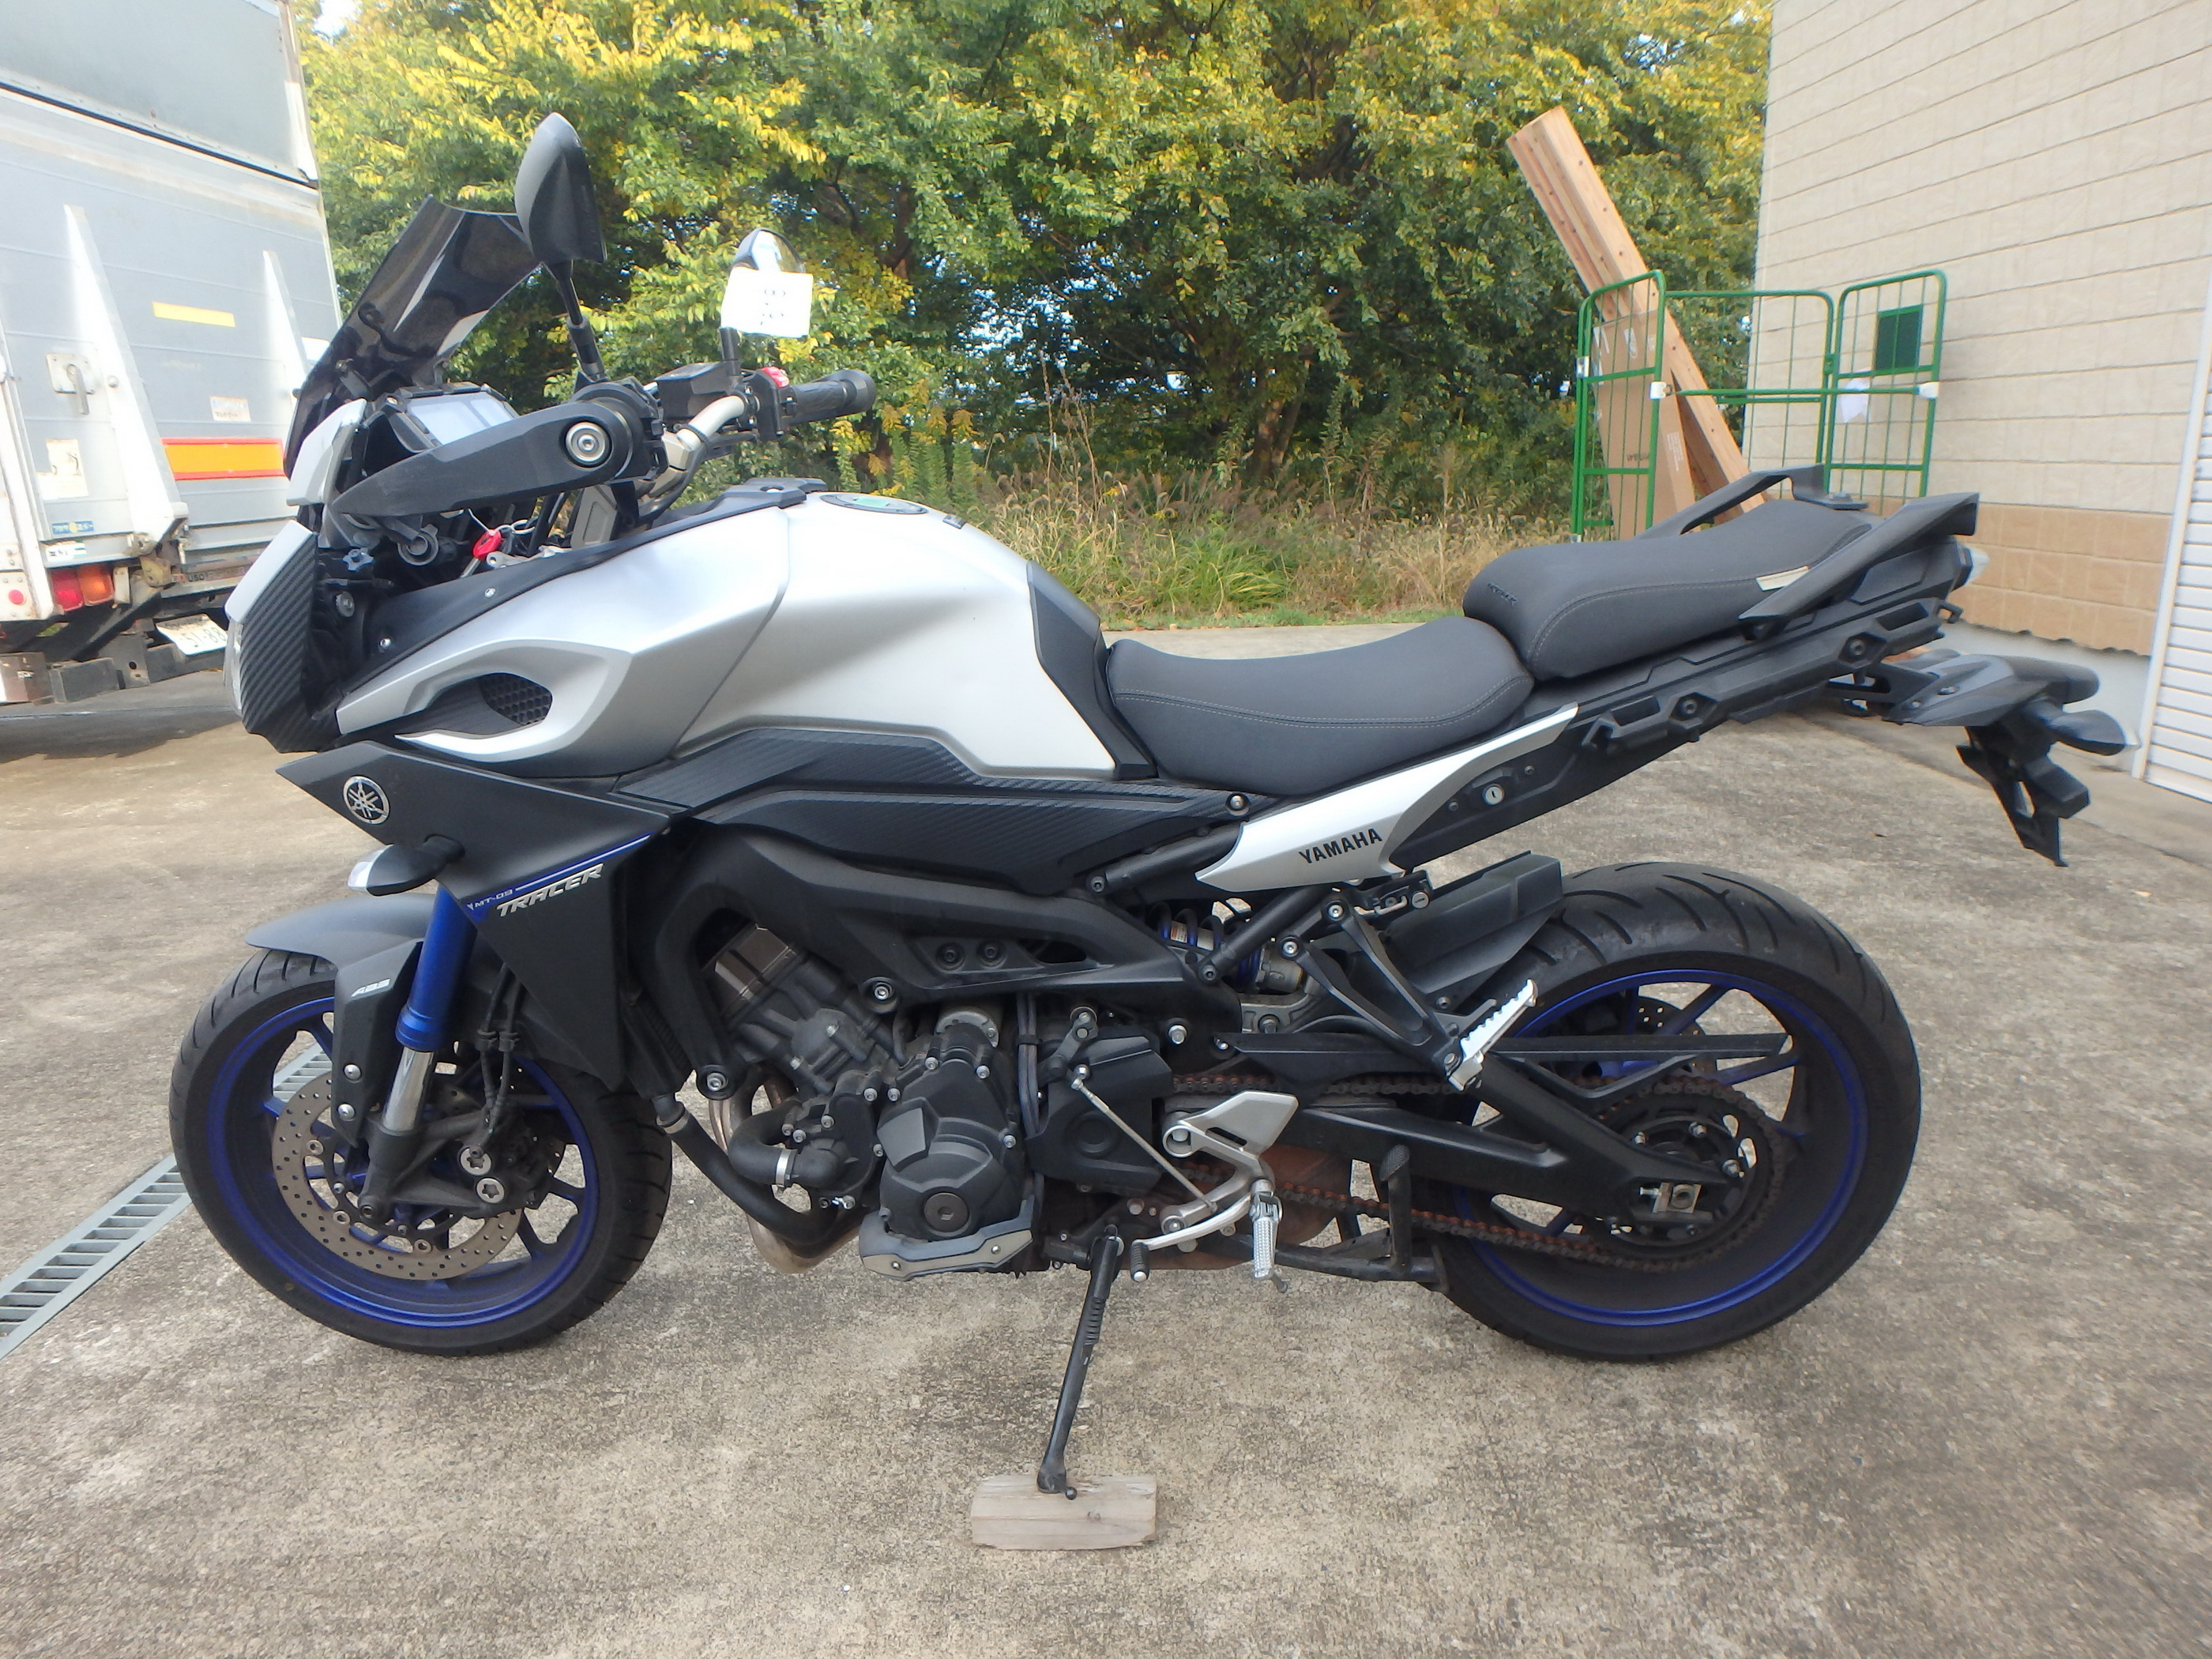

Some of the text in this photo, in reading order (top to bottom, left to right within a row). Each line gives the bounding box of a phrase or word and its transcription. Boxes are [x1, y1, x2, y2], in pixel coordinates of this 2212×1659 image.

[1298, 828, 1382, 863] YAMAHA
[474, 889, 513, 908] MT-09
[496, 863, 604, 917] TRACER
